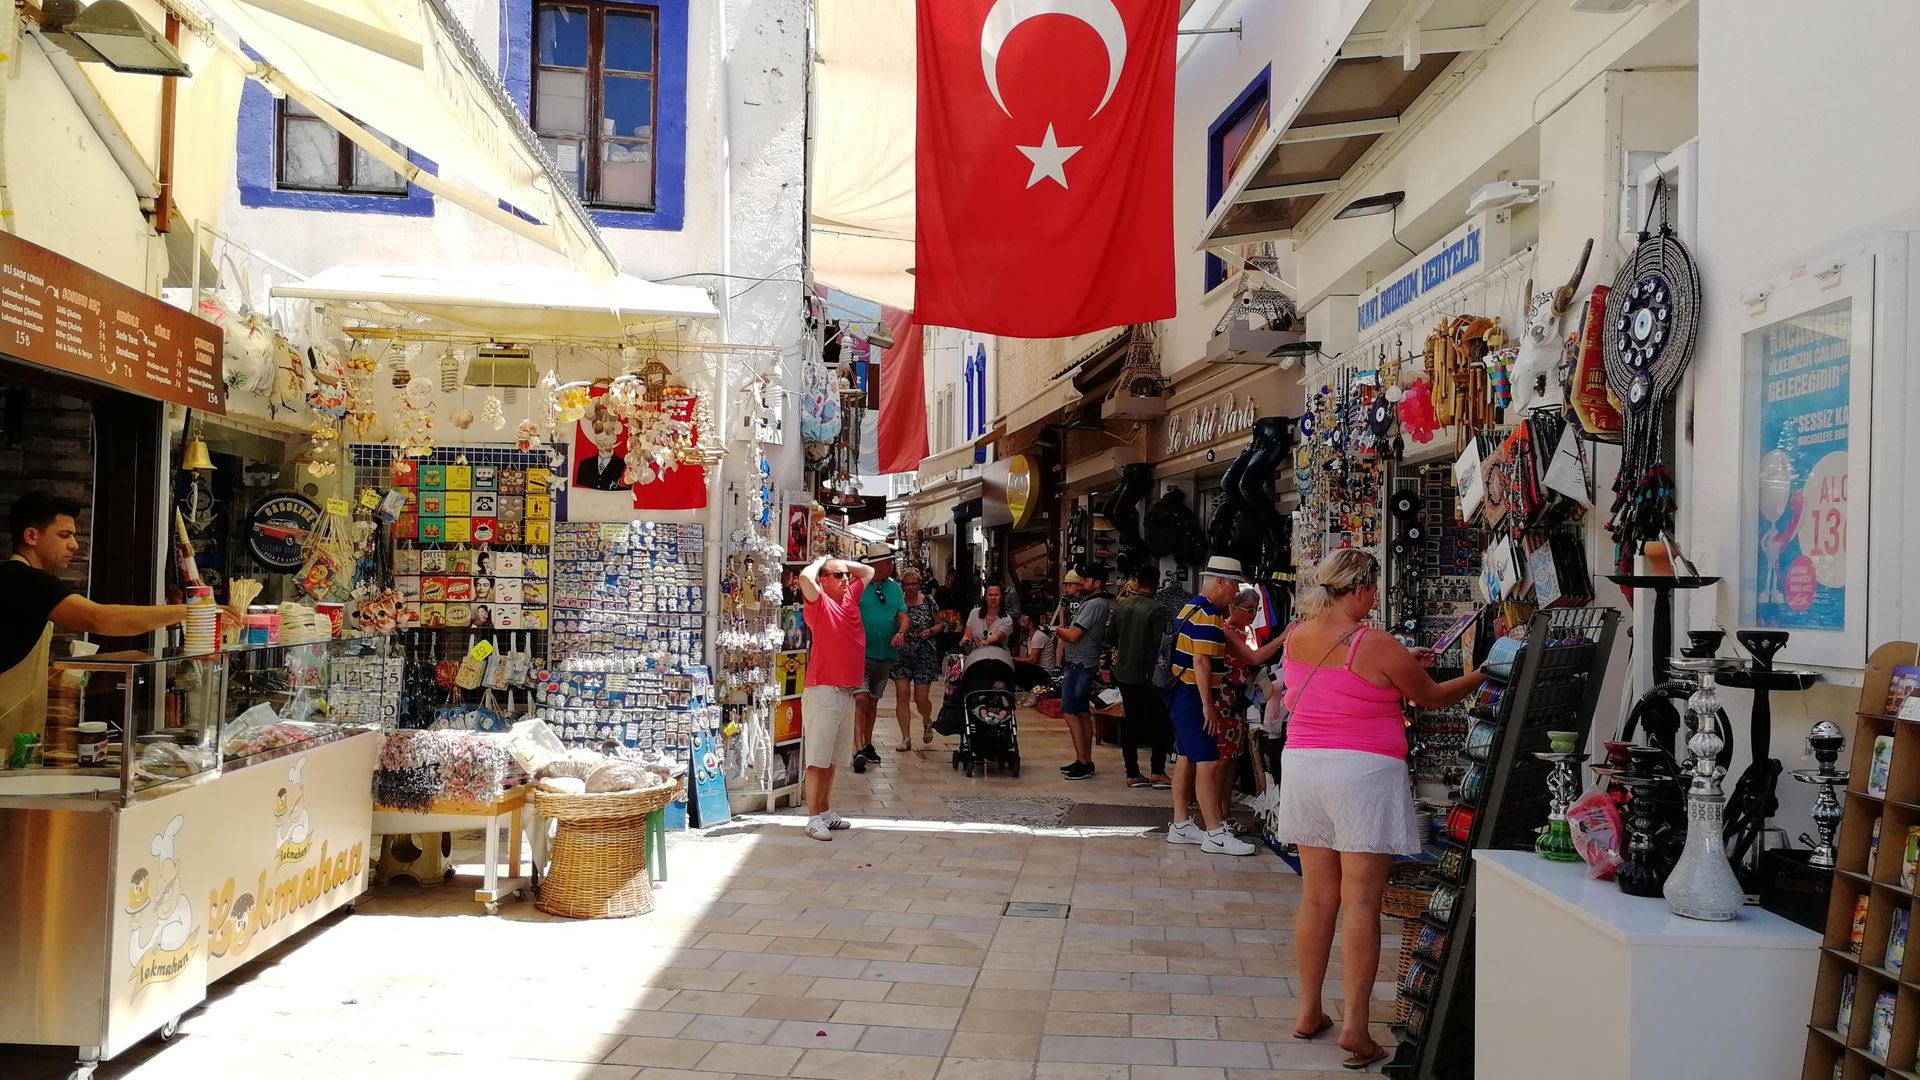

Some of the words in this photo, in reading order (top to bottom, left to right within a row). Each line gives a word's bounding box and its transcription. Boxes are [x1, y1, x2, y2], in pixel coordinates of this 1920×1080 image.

[1381, 268, 1418, 319] BODRUM
[1185, 402, 1217, 449] Petit
[1217, 392, 1256, 437] Paris
